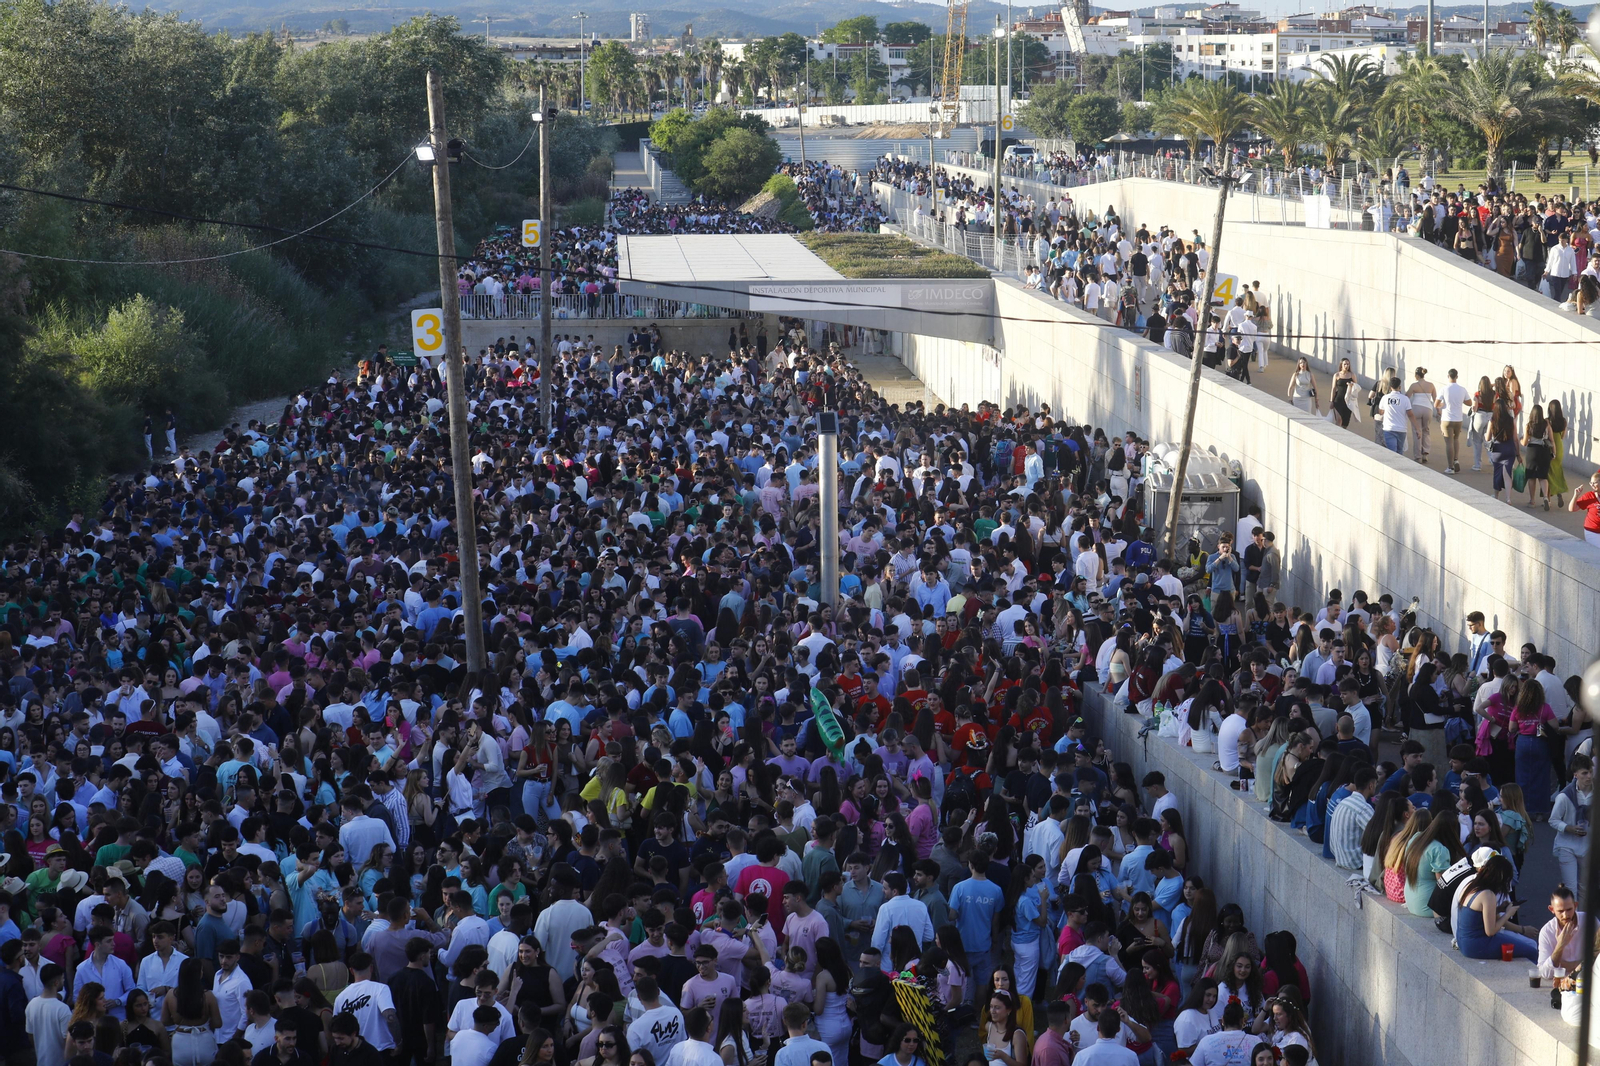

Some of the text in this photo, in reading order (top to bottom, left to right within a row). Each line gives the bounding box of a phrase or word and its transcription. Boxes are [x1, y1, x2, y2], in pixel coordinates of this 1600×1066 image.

[1002, 114, 1013, 130] 6
[936, 190, 944, 201] 7
[524, 222, 540, 244] 5
[925, 288, 984, 300] IMDECO
[1213, 277, 1234, 305] 4
[416, 313, 443, 351] 3
[975, 895, 995, 905] ADE
